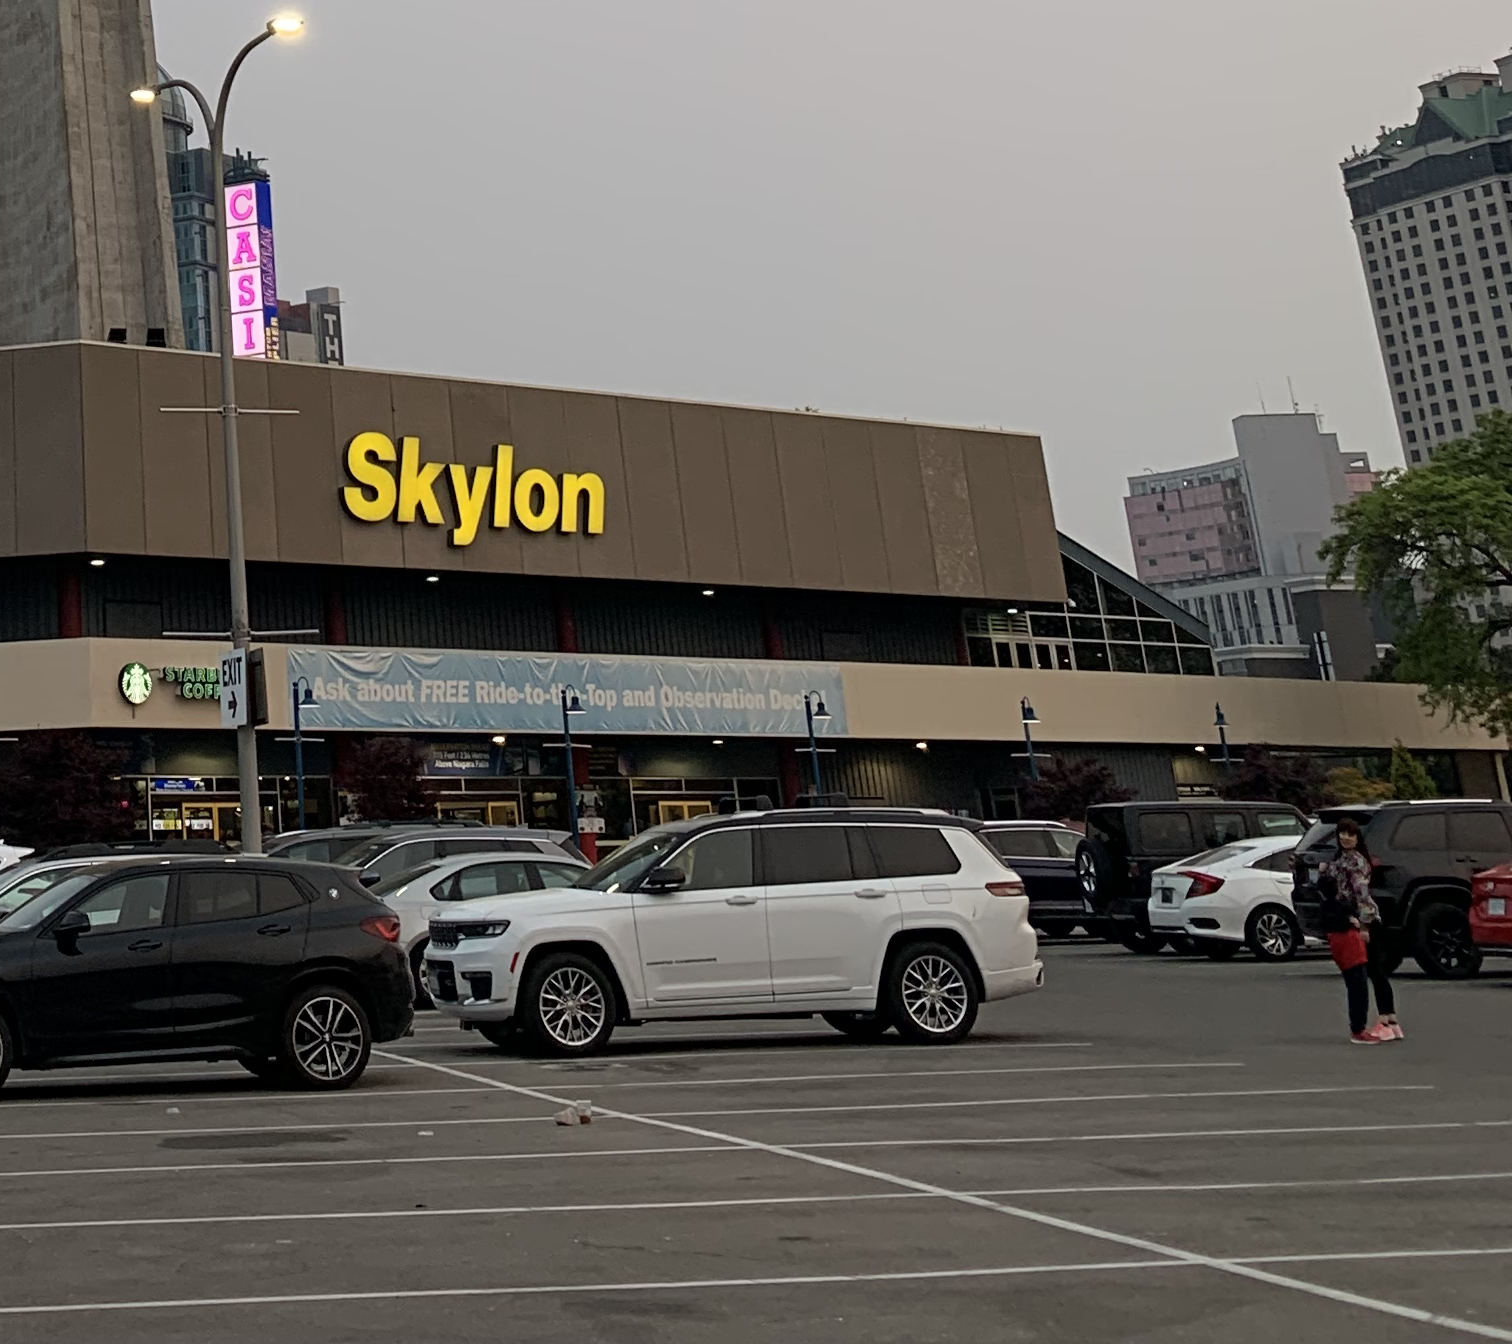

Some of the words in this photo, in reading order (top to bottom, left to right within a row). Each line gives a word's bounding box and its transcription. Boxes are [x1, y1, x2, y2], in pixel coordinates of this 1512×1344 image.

[229, 187, 257, 351] CASI
[323, 312, 340, 365] TH
[343, 431, 605, 547] Skylon
[164, 665, 221, 683] STARB
[221, 656, 243, 688] EXIT
[182, 682, 221, 700] COFF
[313, 676, 352, 702] Ask
[356, 678, 416, 703] about
[419, 679, 470, 704] FREE
[622, 685, 656, 708] and
[660, 684, 767, 711] Observation
